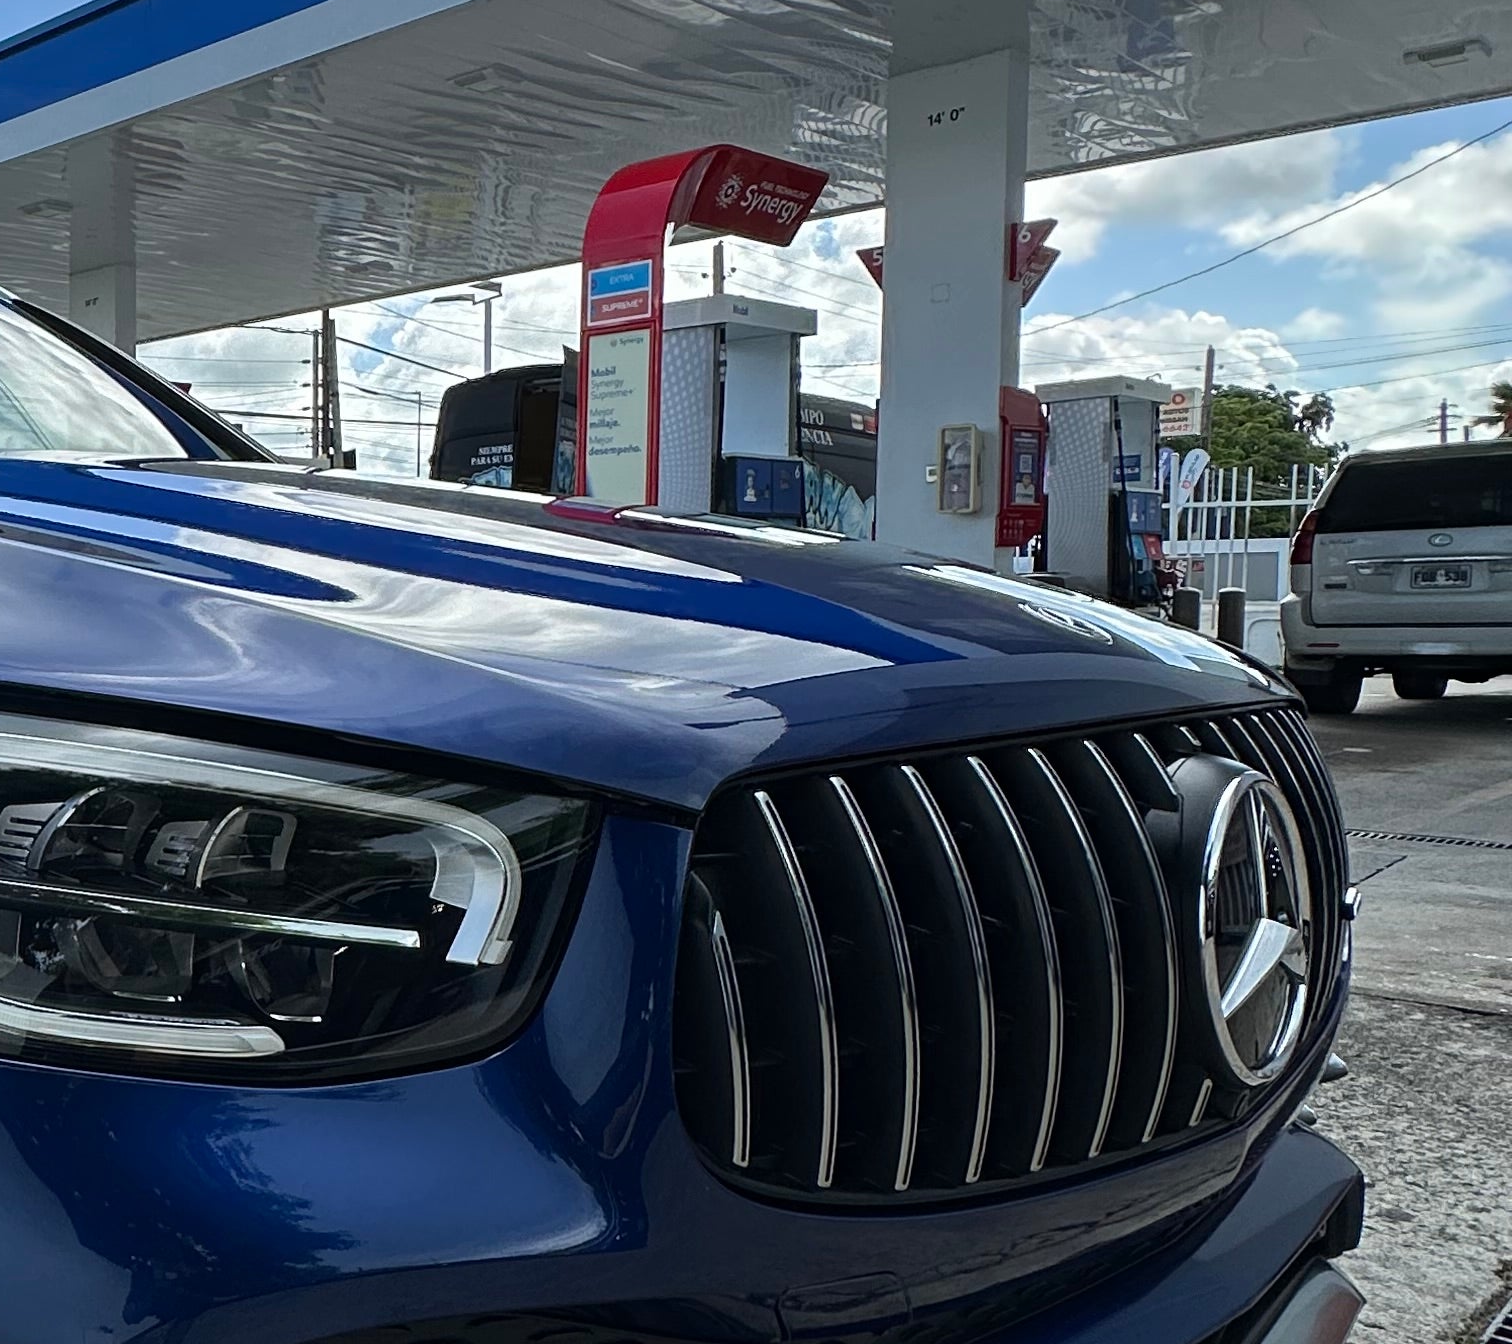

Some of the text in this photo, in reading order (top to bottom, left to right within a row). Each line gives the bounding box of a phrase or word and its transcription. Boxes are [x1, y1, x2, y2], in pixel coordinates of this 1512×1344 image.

[740, 184, 803, 225] Synergy
[1018, 226, 1031, 243] 6
[872, 249, 883, 265] 5
[609, 273, 634, 285] EXTRA
[591, 366, 616, 377] Mobil
[591, 379, 624, 390] Synergy
[478, 444, 513, 455] SIEMPRE
[471, 457, 491, 466] PARA
[491, 456, 503, 464] SU
[794, 465, 801, 479] 6
